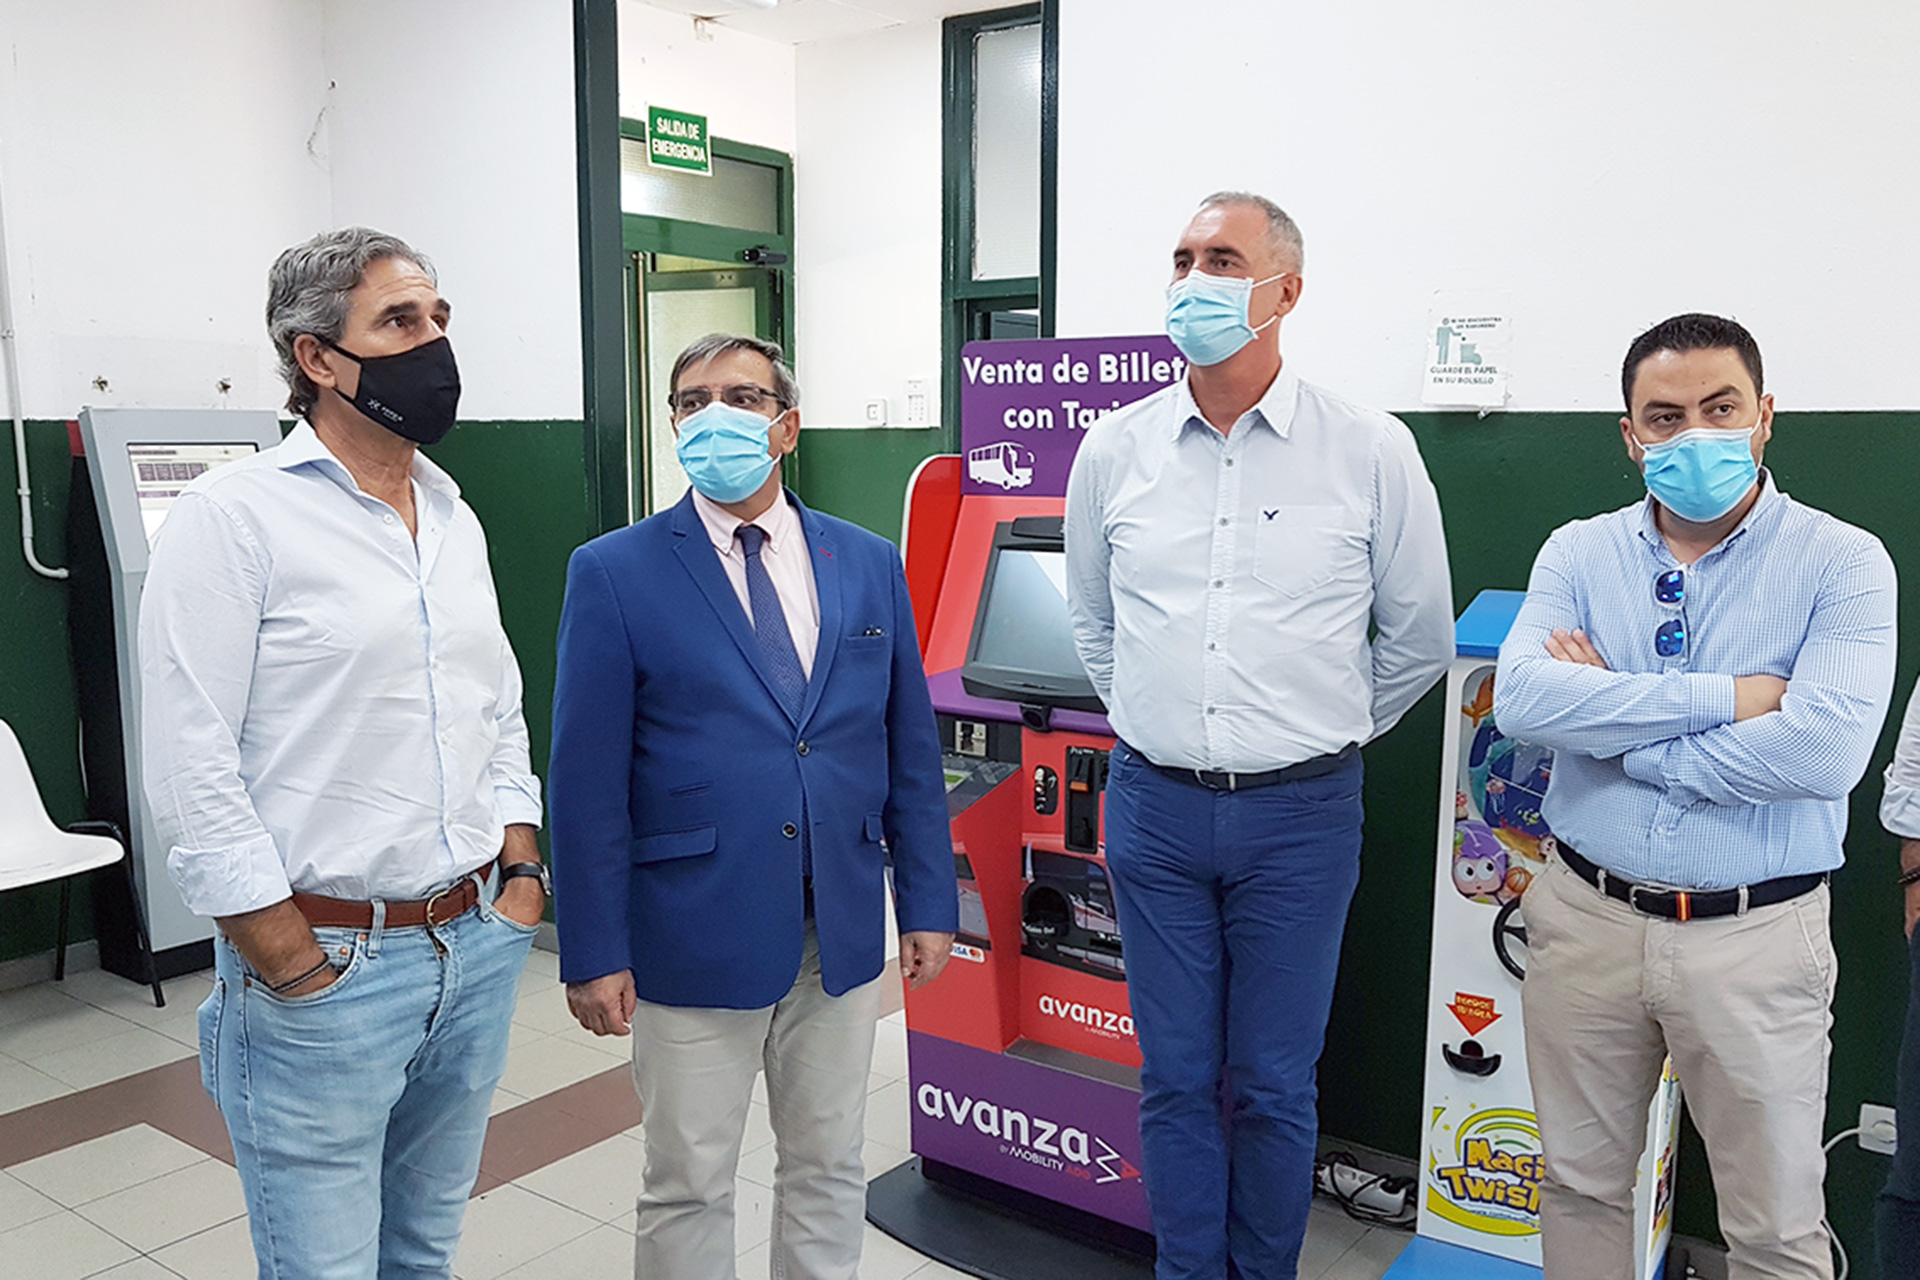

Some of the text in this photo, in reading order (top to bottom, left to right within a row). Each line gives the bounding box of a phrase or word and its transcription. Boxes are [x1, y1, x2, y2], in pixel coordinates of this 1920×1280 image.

[656, 116, 700, 140] SALIDA DE
[651, 137, 707, 163] EMERGENCIA
[963, 351, 1185, 385] Venta de Billet
[1429, 366, 1498, 374] GUARDE EL PAPEL
[1433, 376, 1495, 385] EN SU BOLSILLO
[1003, 407, 1053, 429] con
[1039, 995, 1134, 1036] avanza
[917, 1083, 1091, 1166] avanza
[1009, 1145, 1064, 1172] MOBILITY
